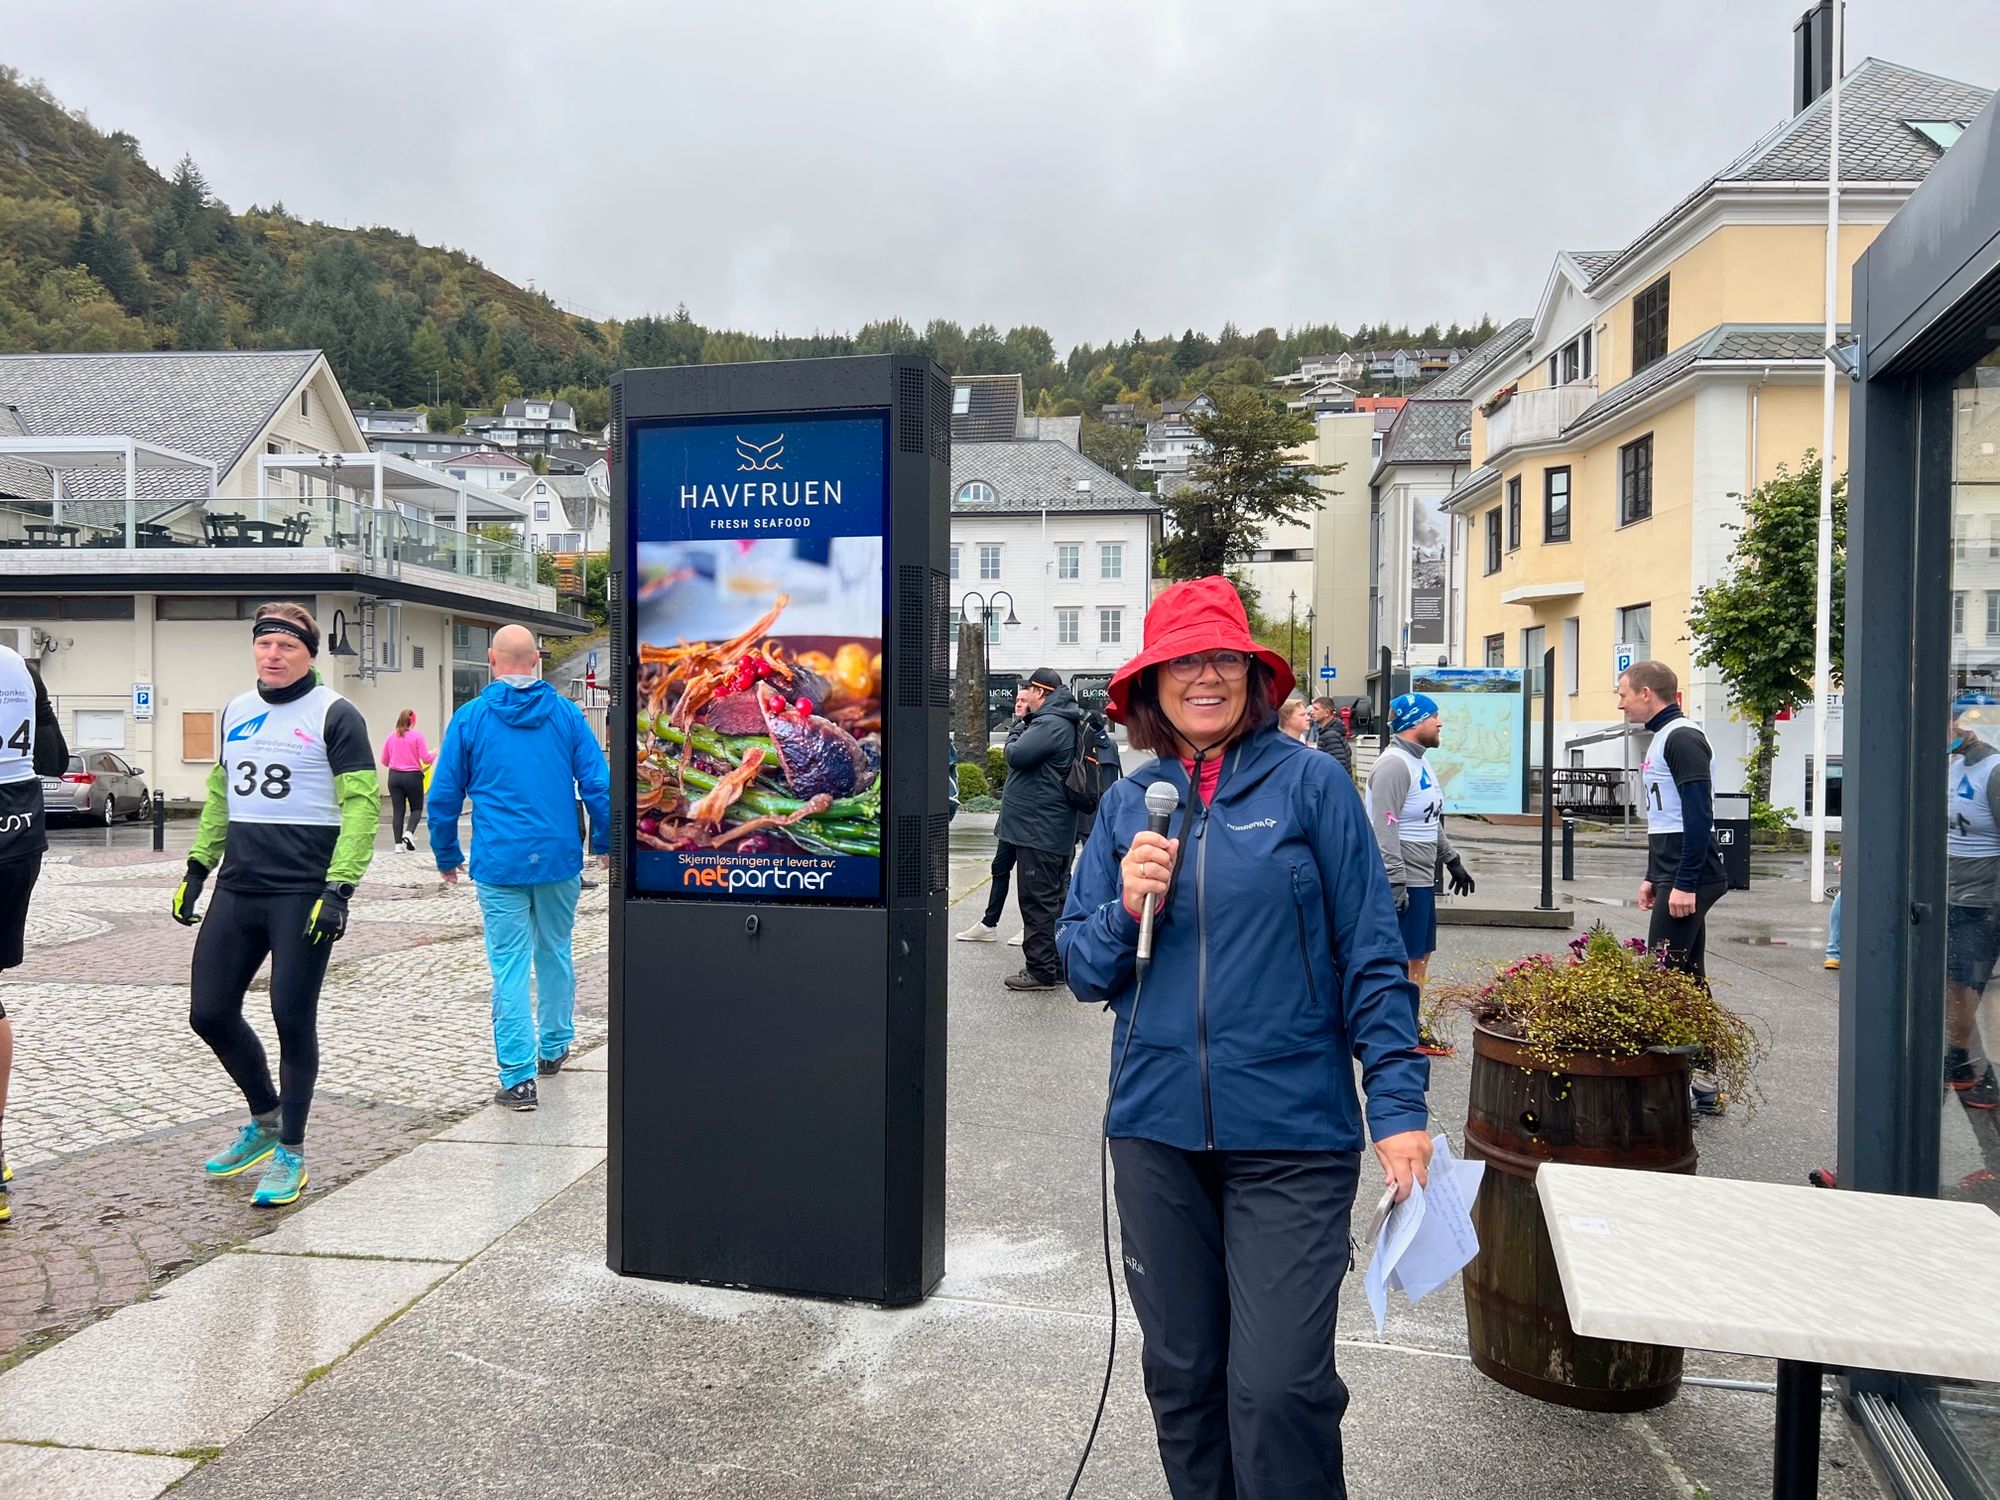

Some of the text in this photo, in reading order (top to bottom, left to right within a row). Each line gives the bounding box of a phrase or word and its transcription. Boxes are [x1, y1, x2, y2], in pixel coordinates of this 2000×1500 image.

[680, 480, 842, 508] HAVFRUEN
[710, 517, 811, 529] FRESH SEAFOOD
[0, 719, 31, 757] 4
[233, 760, 292, 800] 38
[1645, 782, 1663, 811] 1
[678, 853, 836, 869] Skjermløsningen er levert av:
[684, 864, 833, 893] netpartner
